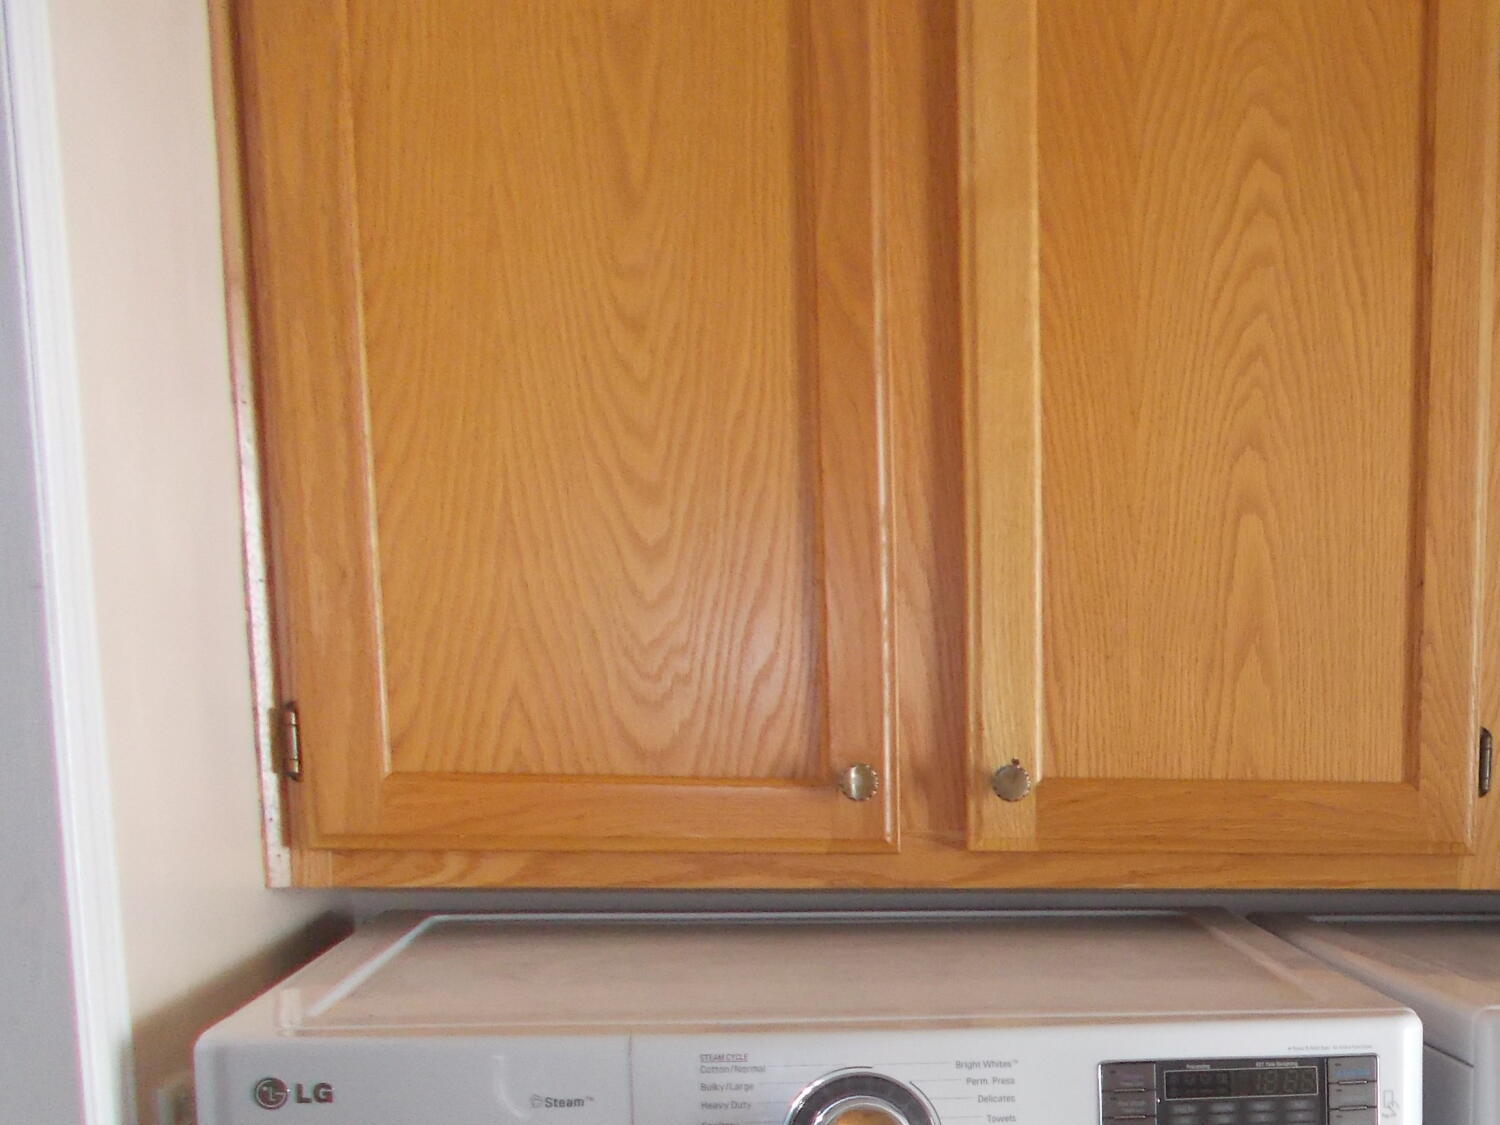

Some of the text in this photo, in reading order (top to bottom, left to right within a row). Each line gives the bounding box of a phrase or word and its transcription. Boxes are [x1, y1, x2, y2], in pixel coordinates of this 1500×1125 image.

[700, 1053, 748, 1062] STEAM CYCLE
[955, 1059, 980, 1070] Bright
[296, 1082, 333, 1104] LG
[977, 1094, 1016, 1103] Delicates
[701, 1100, 751, 1110] Heavy Duty
[987, 1114, 1017, 1123] Towels
